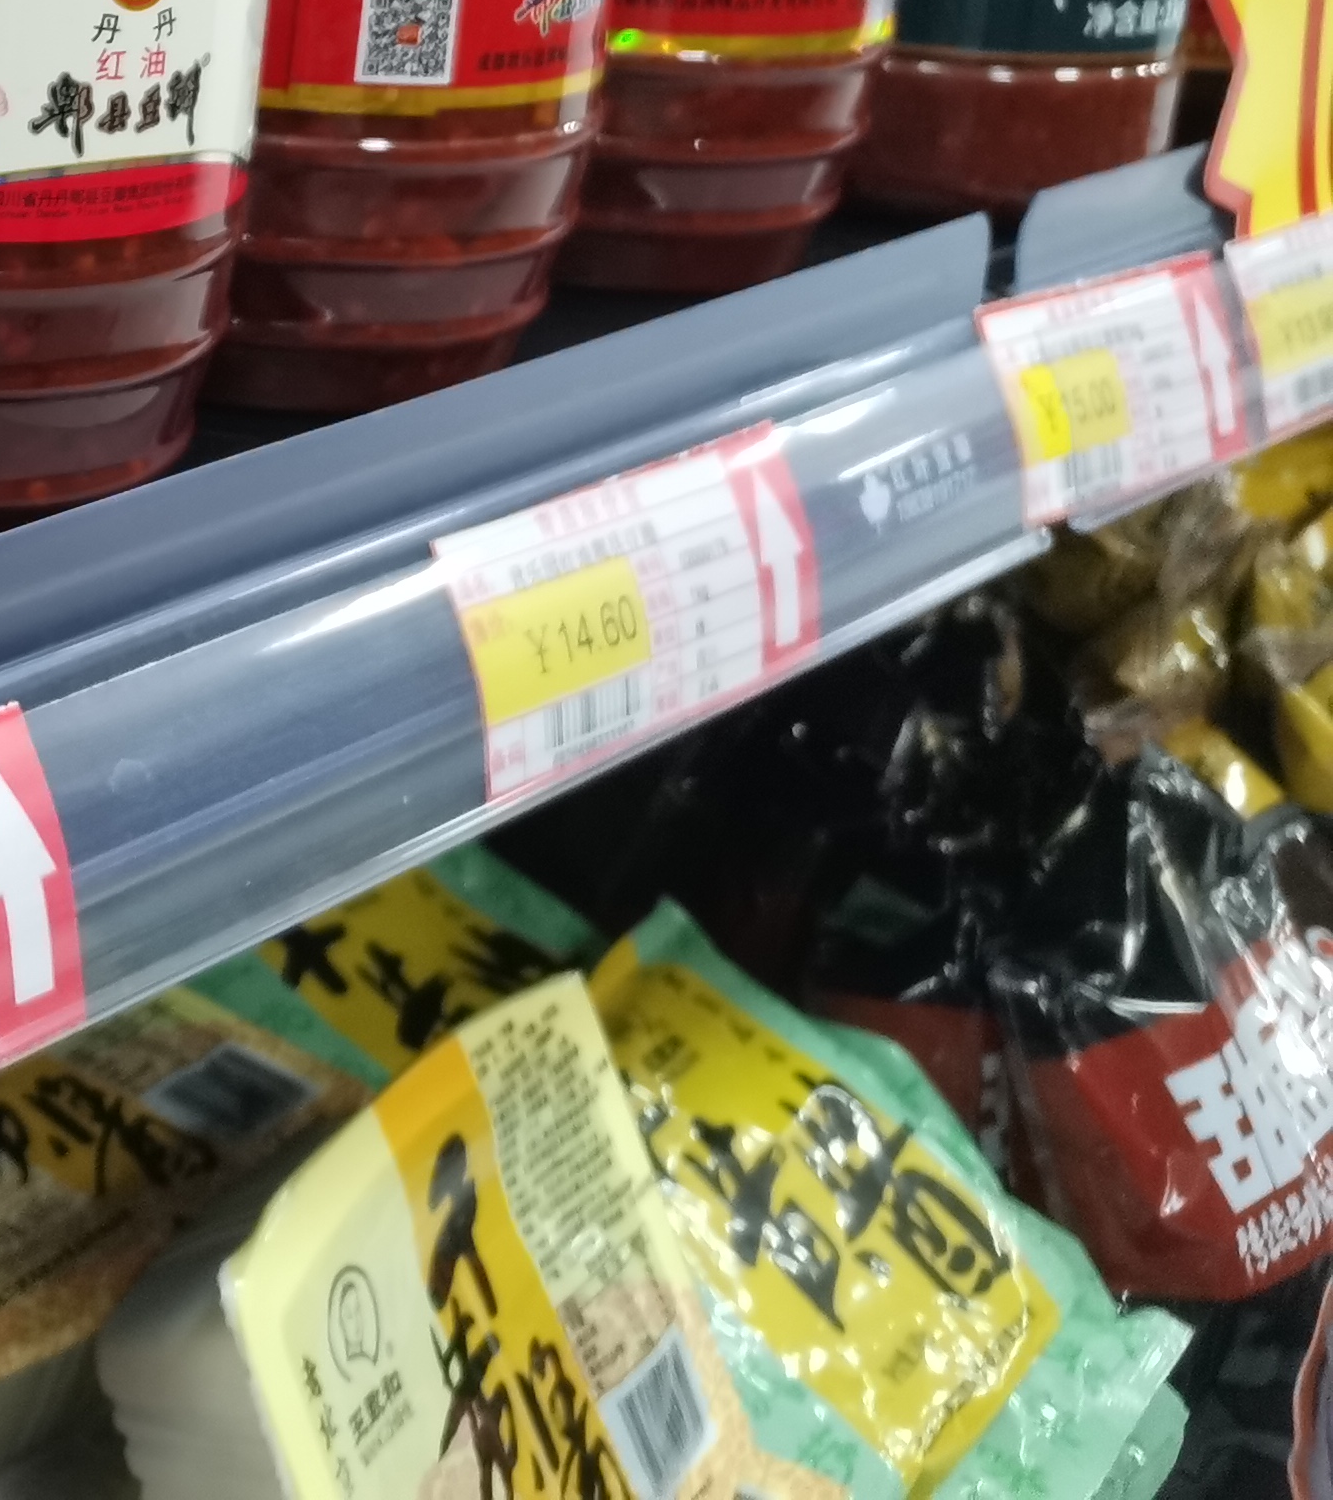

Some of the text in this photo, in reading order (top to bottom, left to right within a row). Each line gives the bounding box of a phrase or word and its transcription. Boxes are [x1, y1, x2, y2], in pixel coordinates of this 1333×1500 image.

[93, 7, 176, 44] 丹丹
[96, 45, 167, 82] 红油
[526, 594, 638, 674] ¥14.60
